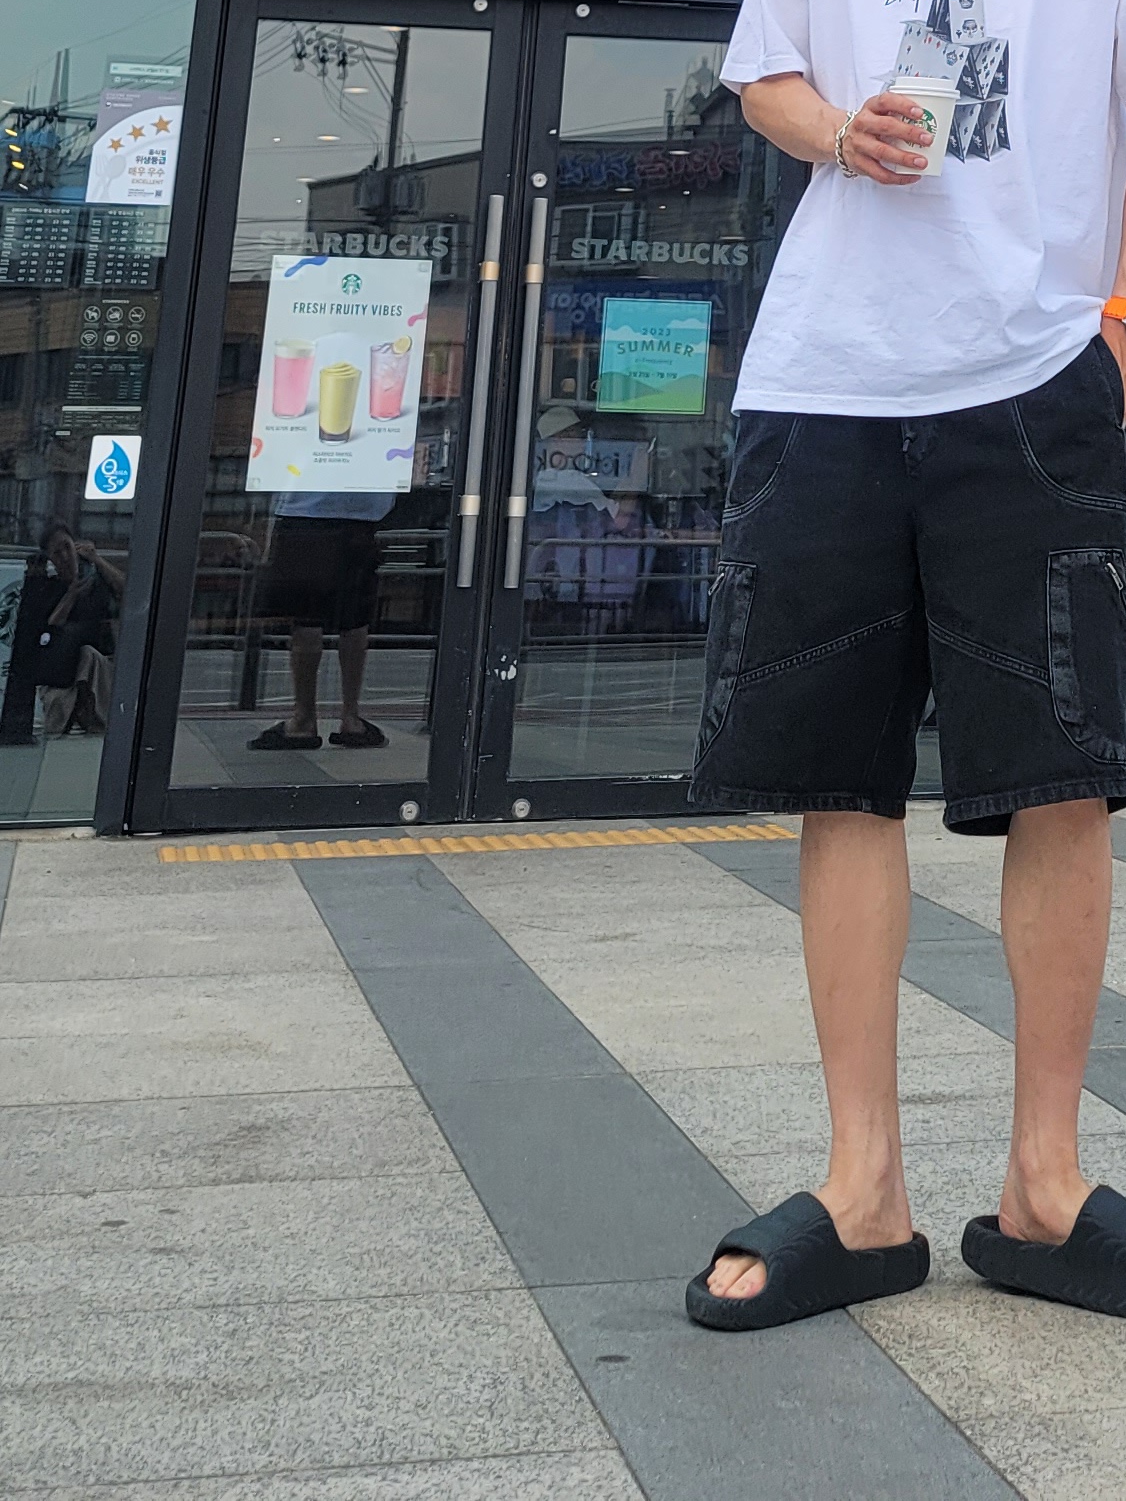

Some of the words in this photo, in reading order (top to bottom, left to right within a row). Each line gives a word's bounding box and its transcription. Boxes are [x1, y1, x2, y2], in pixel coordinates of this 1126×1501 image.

[135, 156, 167, 165] 위생등급
[128, 166, 146, 177] 매우
[147, 167, 166, 178] 우수
[260, 230, 450, 258] STARBUCKS
[570, 237, 750, 267] STARBUCKS
[293, 301, 327, 315] FRESH
[330, 302, 368, 317] FRUITY
[371, 304, 403, 317] VIBES
[641, 327, 671, 337] 2023
[617, 339, 694, 358] SUMMER
